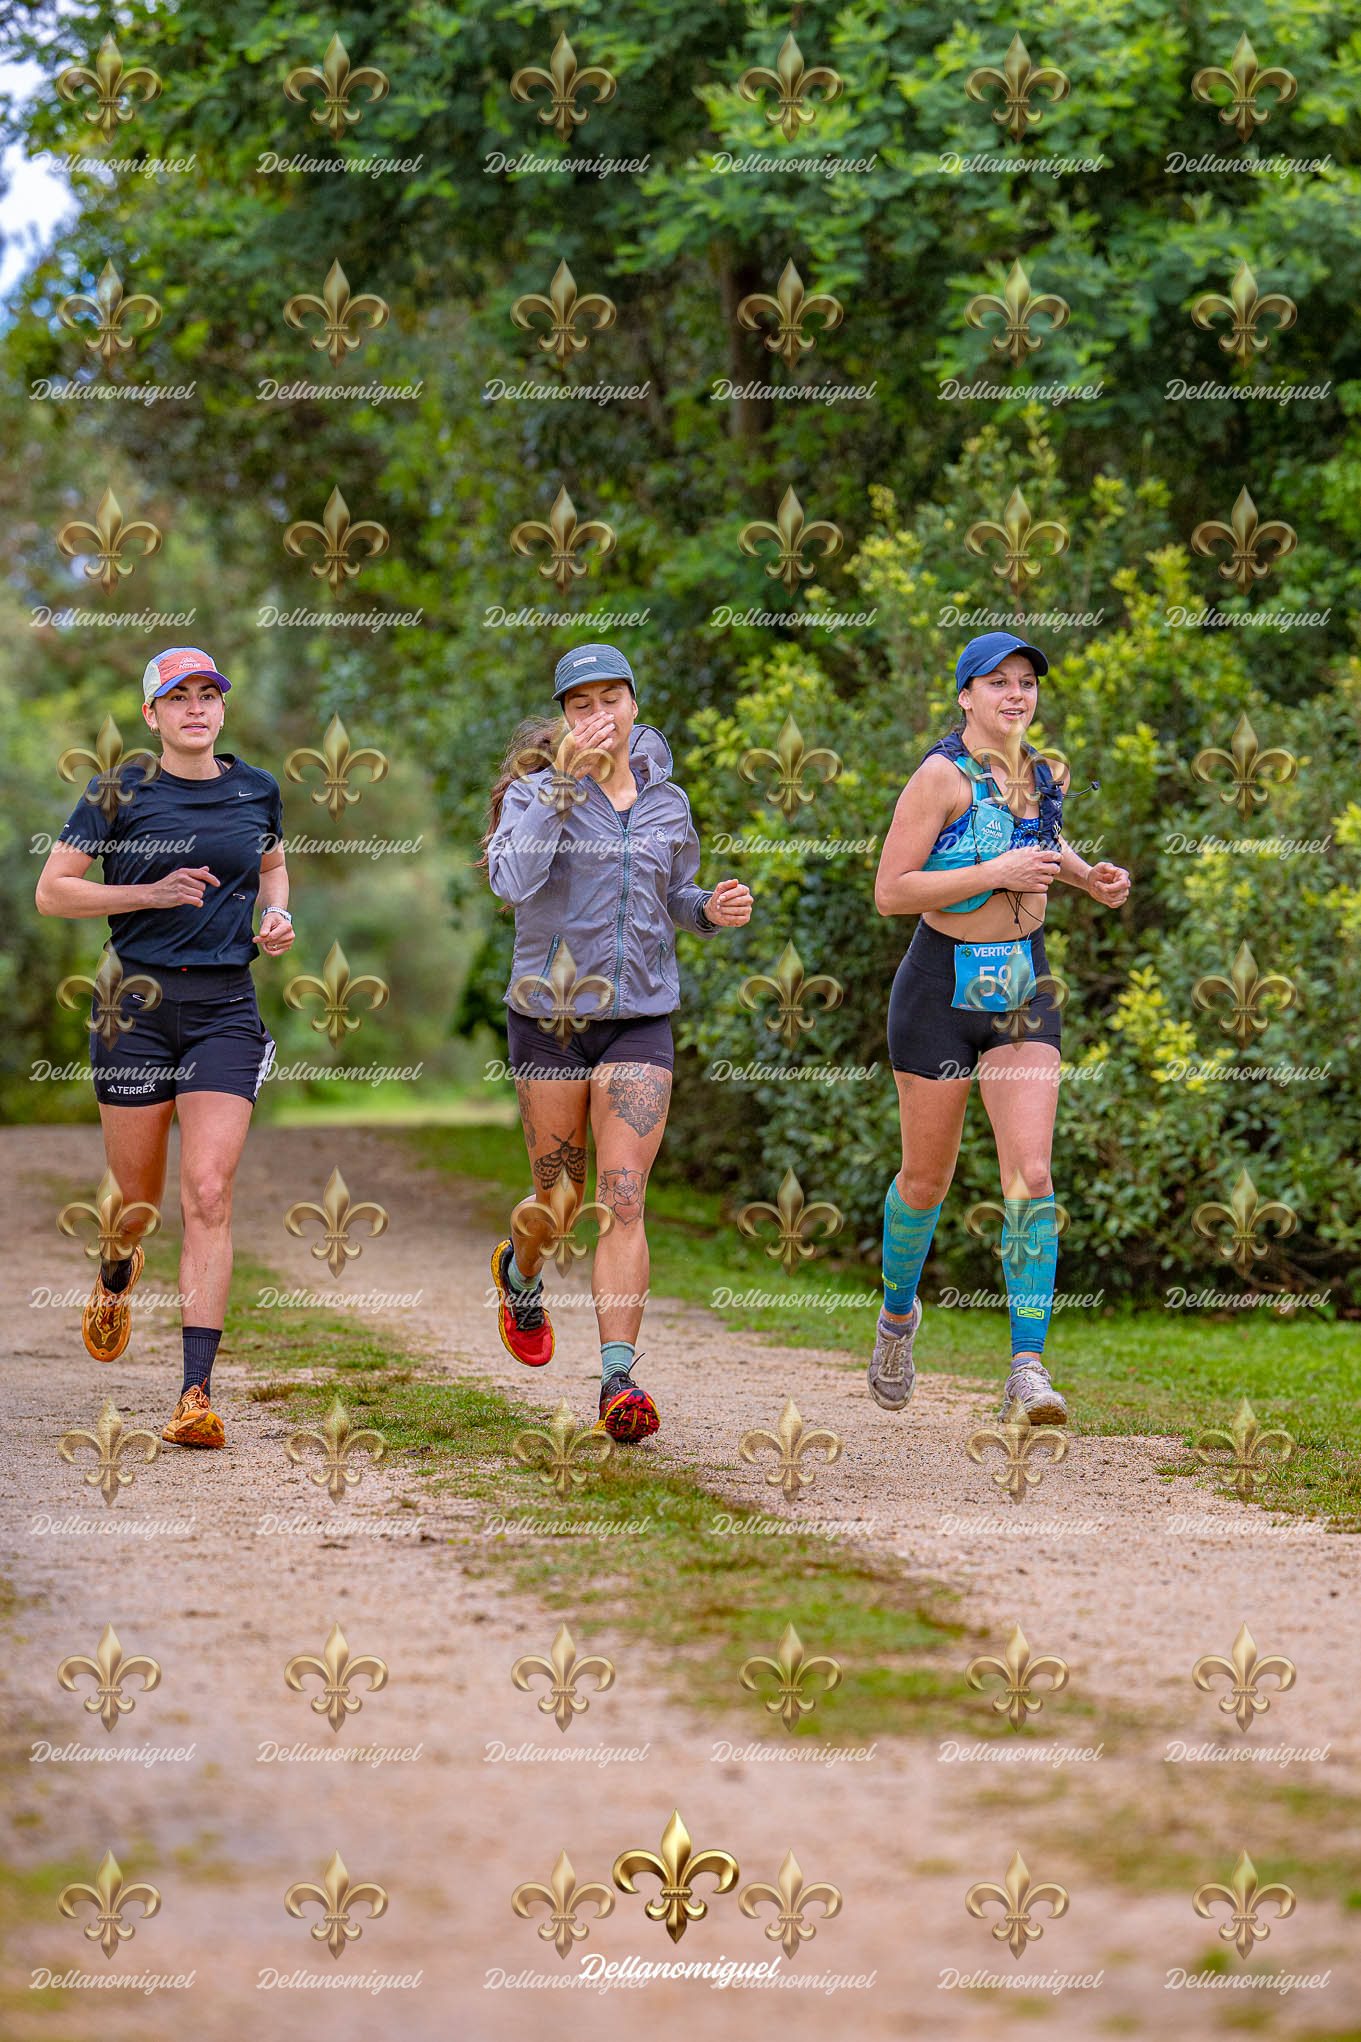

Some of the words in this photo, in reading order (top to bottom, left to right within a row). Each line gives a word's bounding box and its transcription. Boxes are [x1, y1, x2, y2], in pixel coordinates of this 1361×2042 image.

[973, 945, 1022, 957] VERTICAL
[979, 964, 1012, 997] 59
[118, 1083, 155, 1095] TERREX
